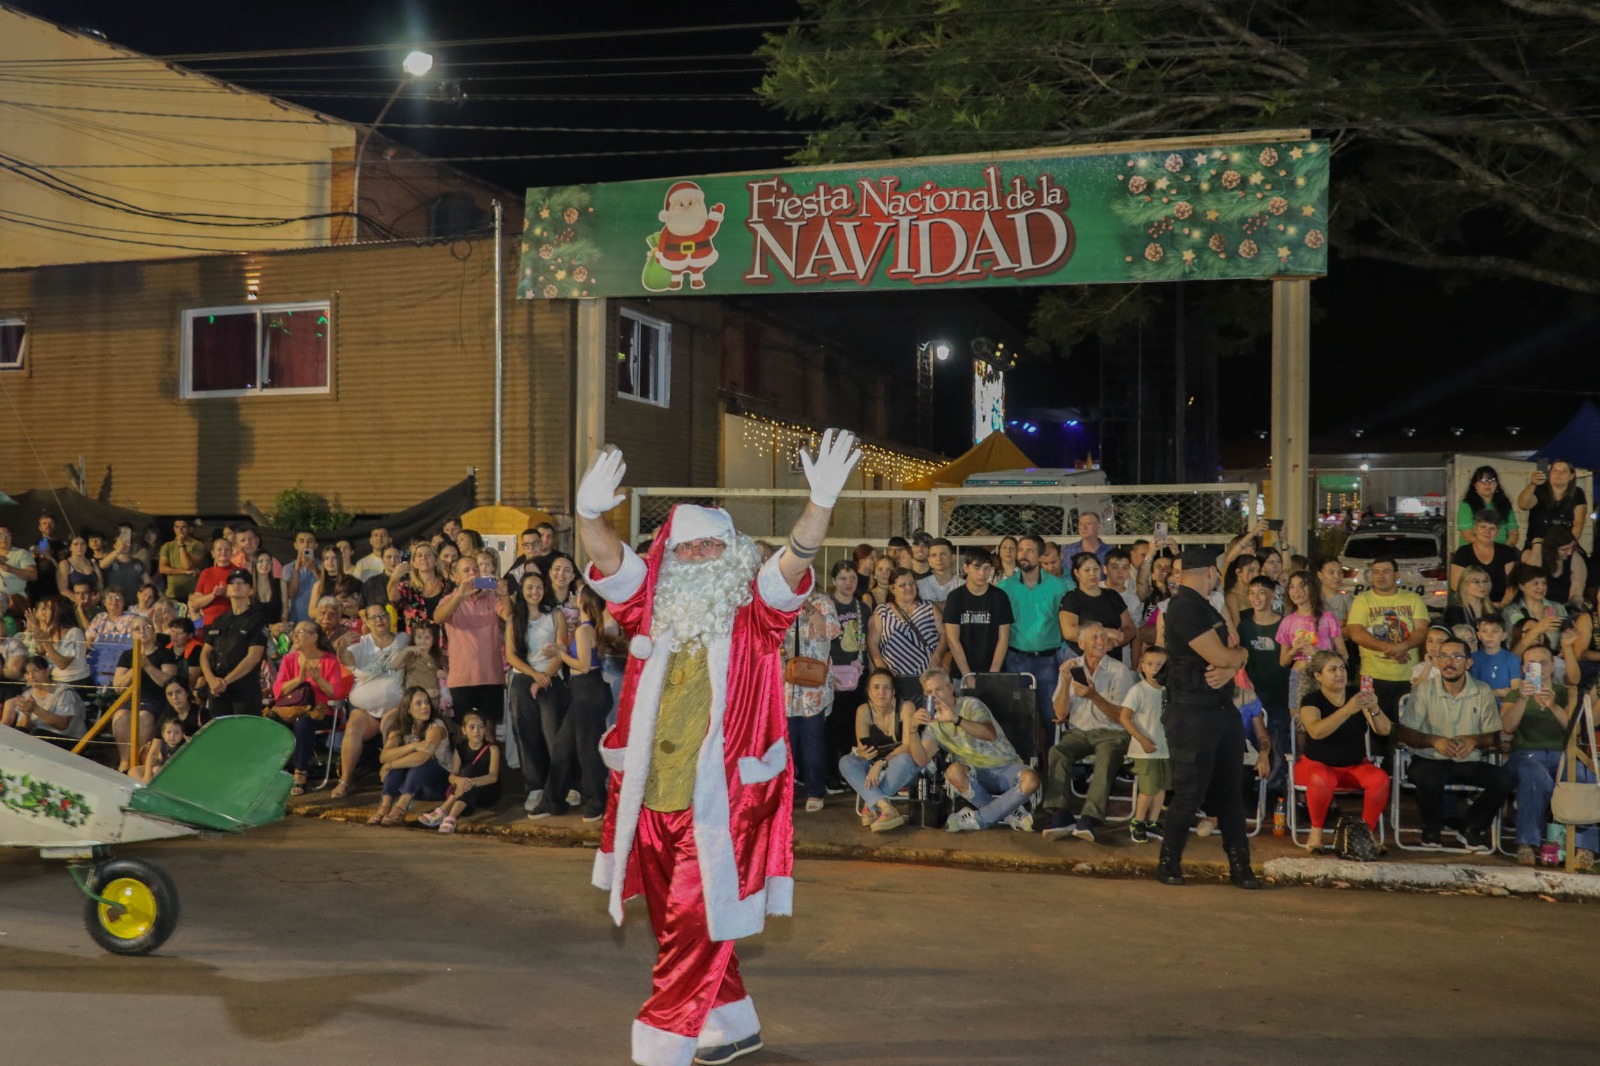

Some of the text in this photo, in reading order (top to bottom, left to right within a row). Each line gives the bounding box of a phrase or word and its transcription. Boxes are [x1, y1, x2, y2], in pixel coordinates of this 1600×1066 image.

[748, 166, 1063, 222] Fiesta Nacional de la
[746, 208, 1068, 280] NAVIDAD
